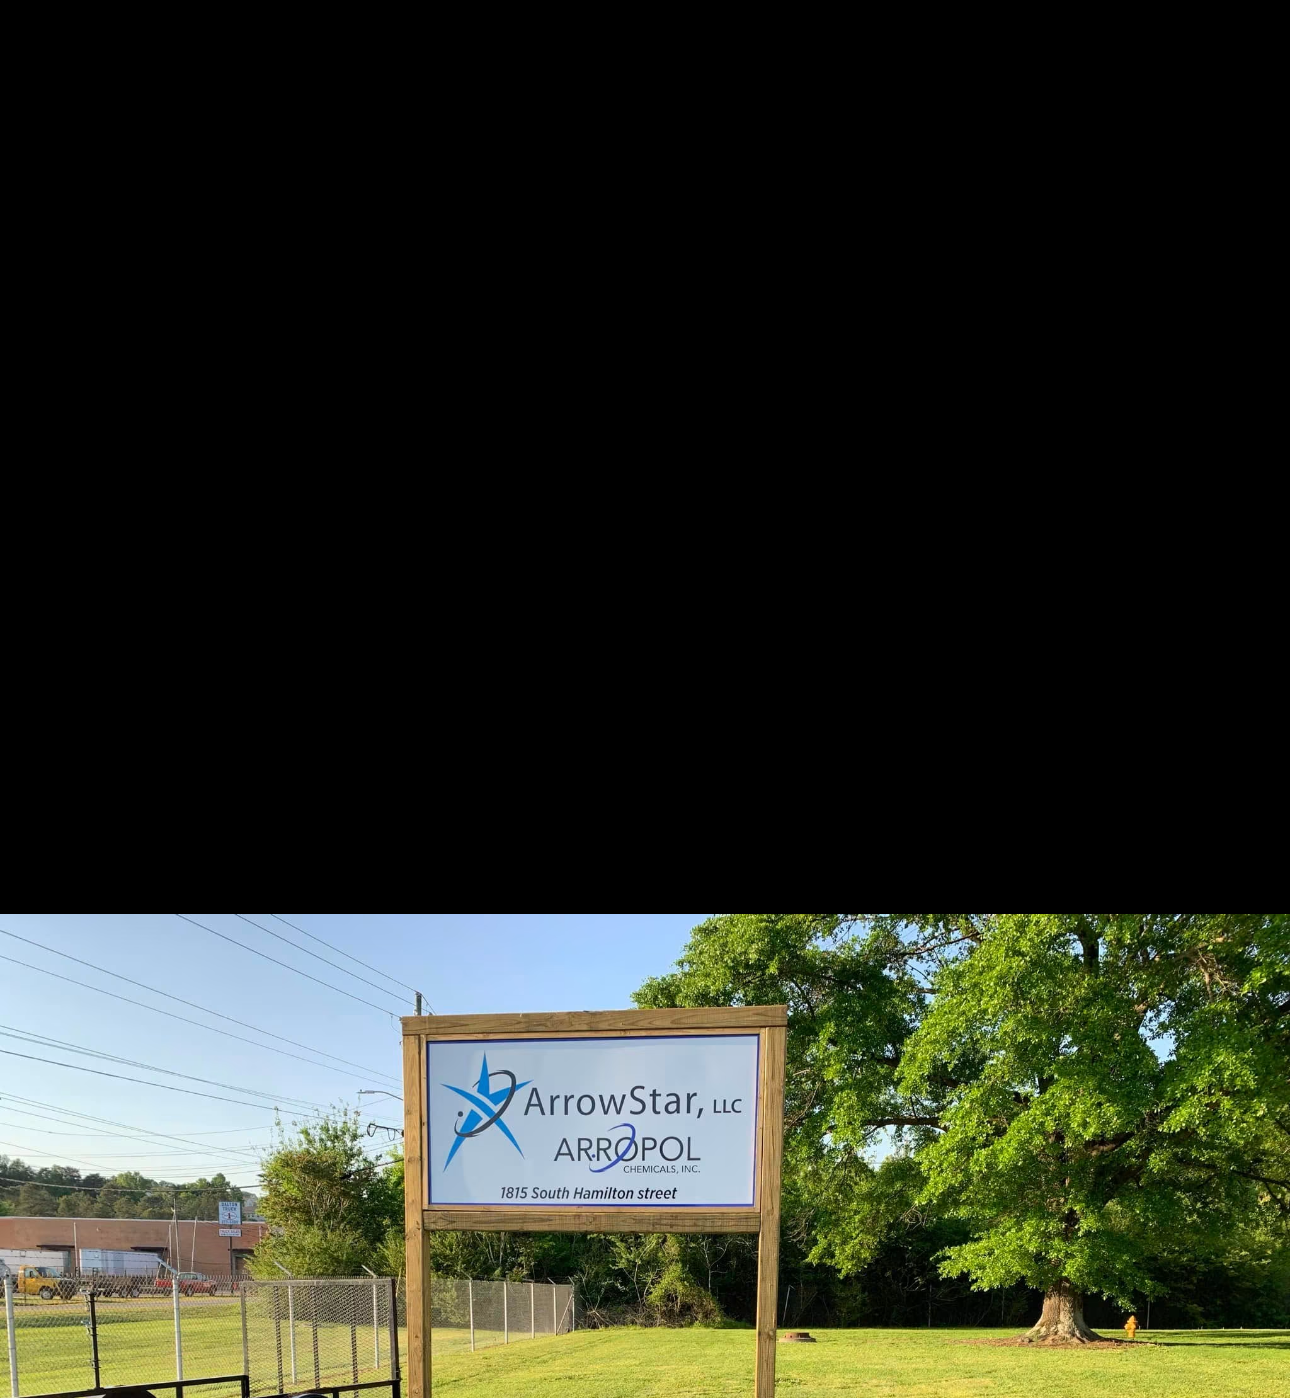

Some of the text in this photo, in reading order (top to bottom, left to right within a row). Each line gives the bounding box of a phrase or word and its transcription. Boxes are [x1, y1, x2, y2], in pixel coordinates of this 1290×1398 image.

[523, 1085, 742, 1119] ArrowStar, LLC
[553, 1136, 701, 1162] ARROPOL
[623, 1165, 701, 1174] CHEMICALS, INC.
[500, 1186, 678, 1200] 1815 South Hamilton street
